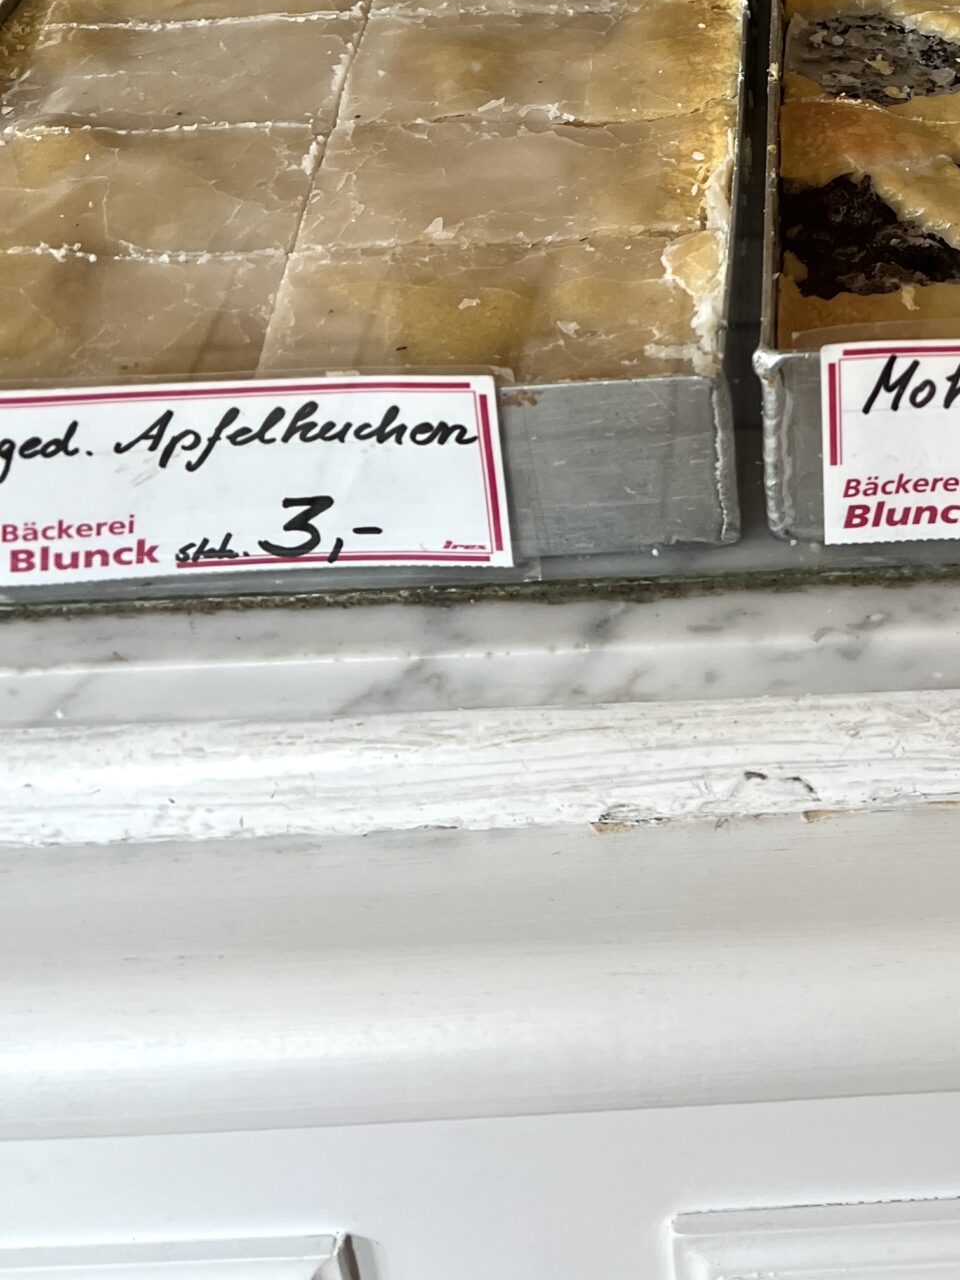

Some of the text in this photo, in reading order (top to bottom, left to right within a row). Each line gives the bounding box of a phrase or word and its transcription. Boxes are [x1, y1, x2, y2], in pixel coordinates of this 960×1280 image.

[0, 401, 480, 484] ged. Apfelkuchen
[1, 514, 135, 543] Bäckerei
[258, 495, 384, 564] 3,-
[10, 538, 160, 573] Blunck
